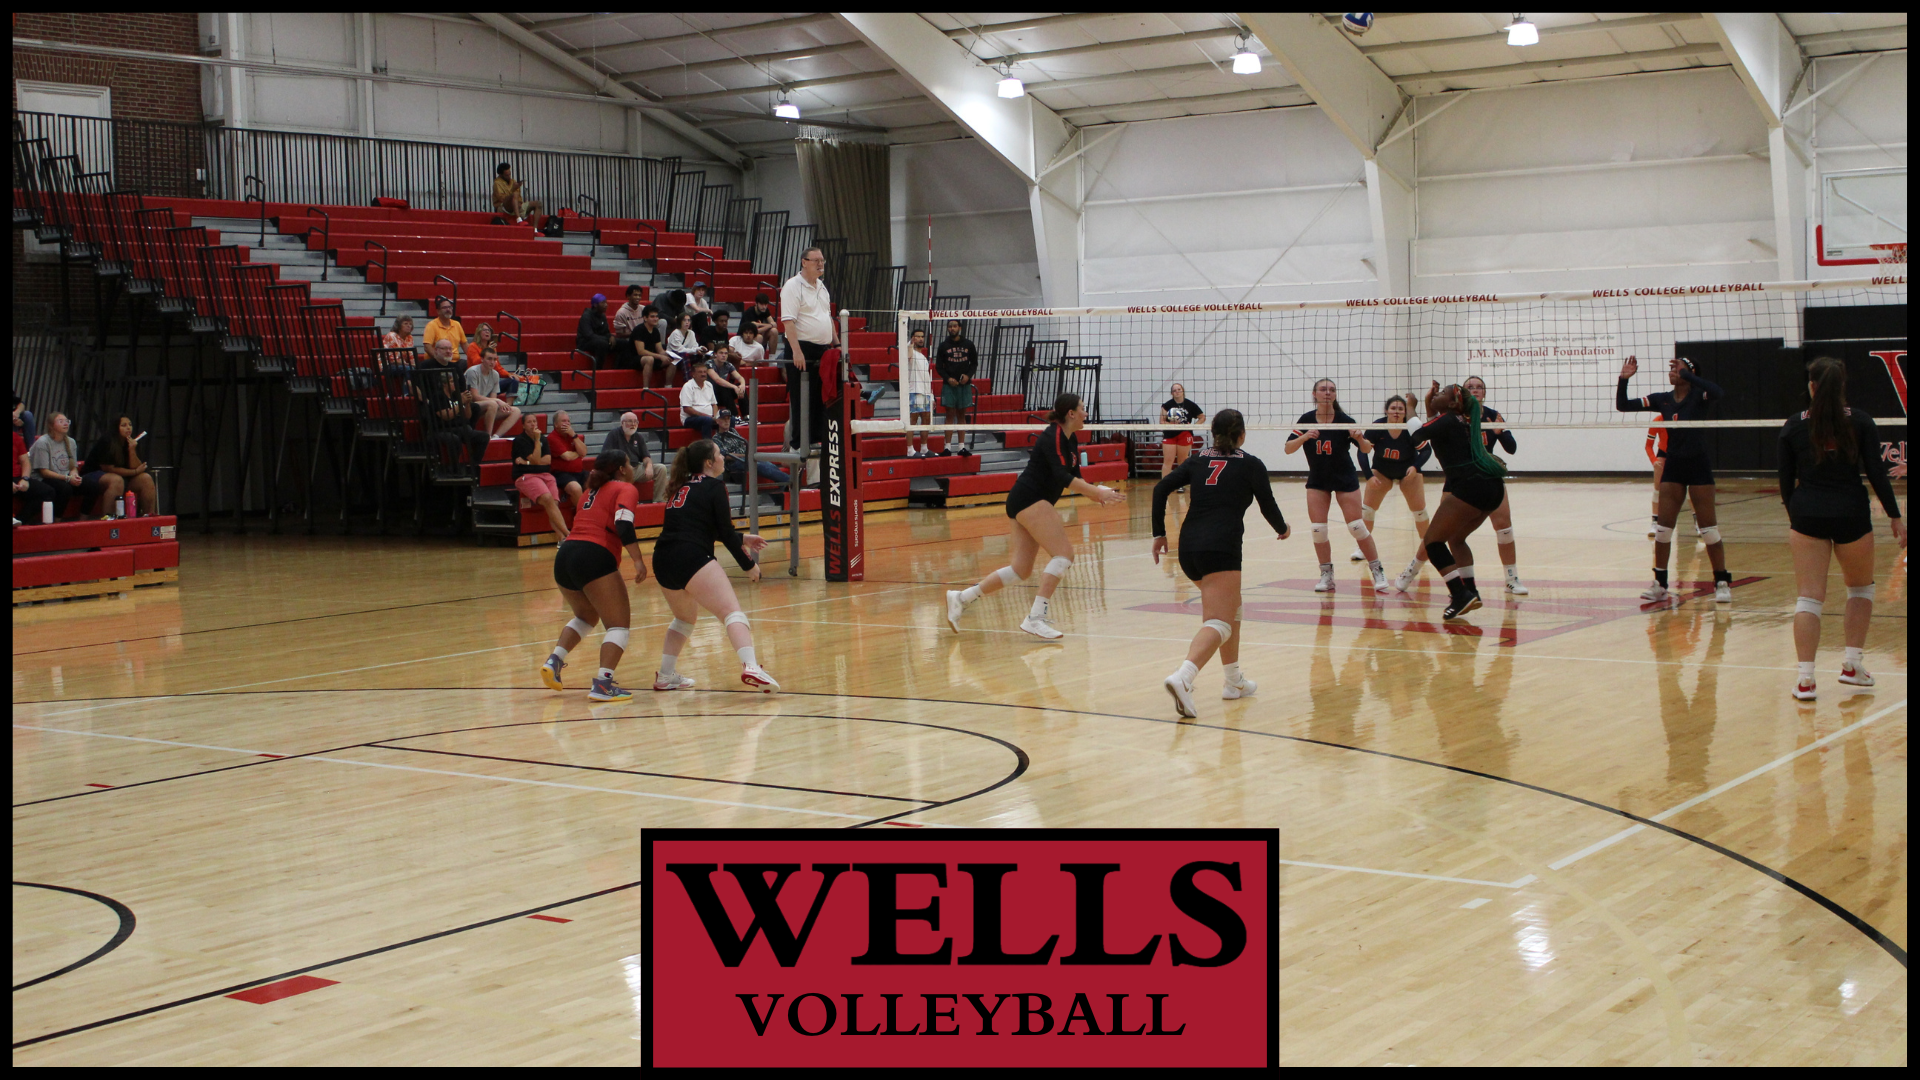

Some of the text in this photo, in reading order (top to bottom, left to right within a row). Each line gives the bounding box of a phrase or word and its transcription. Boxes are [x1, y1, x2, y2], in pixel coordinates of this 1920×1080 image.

[1872, 276, 1907, 285] WELL
[1592, 283, 1765, 298] WELLS COLLEGE VOLLEYBALL
[1127, 302, 1263, 314] WELLS COLLEGE VOLLEYBALL
[1346, 294, 1498, 307] WELLS COLLEGE VOLLEYBALL
[933, 308, 1054, 318] WELLS COLLEGE VOLLEYBALL
[1467, 345, 1615, 361] J.M. McDonald Foundation
[1316, 440, 1332, 455] 14
[1383, 448, 1400, 460] 10
[1205, 460, 1228, 485] 7
[586, 488, 599, 510] 3
[829, 419, 841, 575] WELLS EXPRESS
